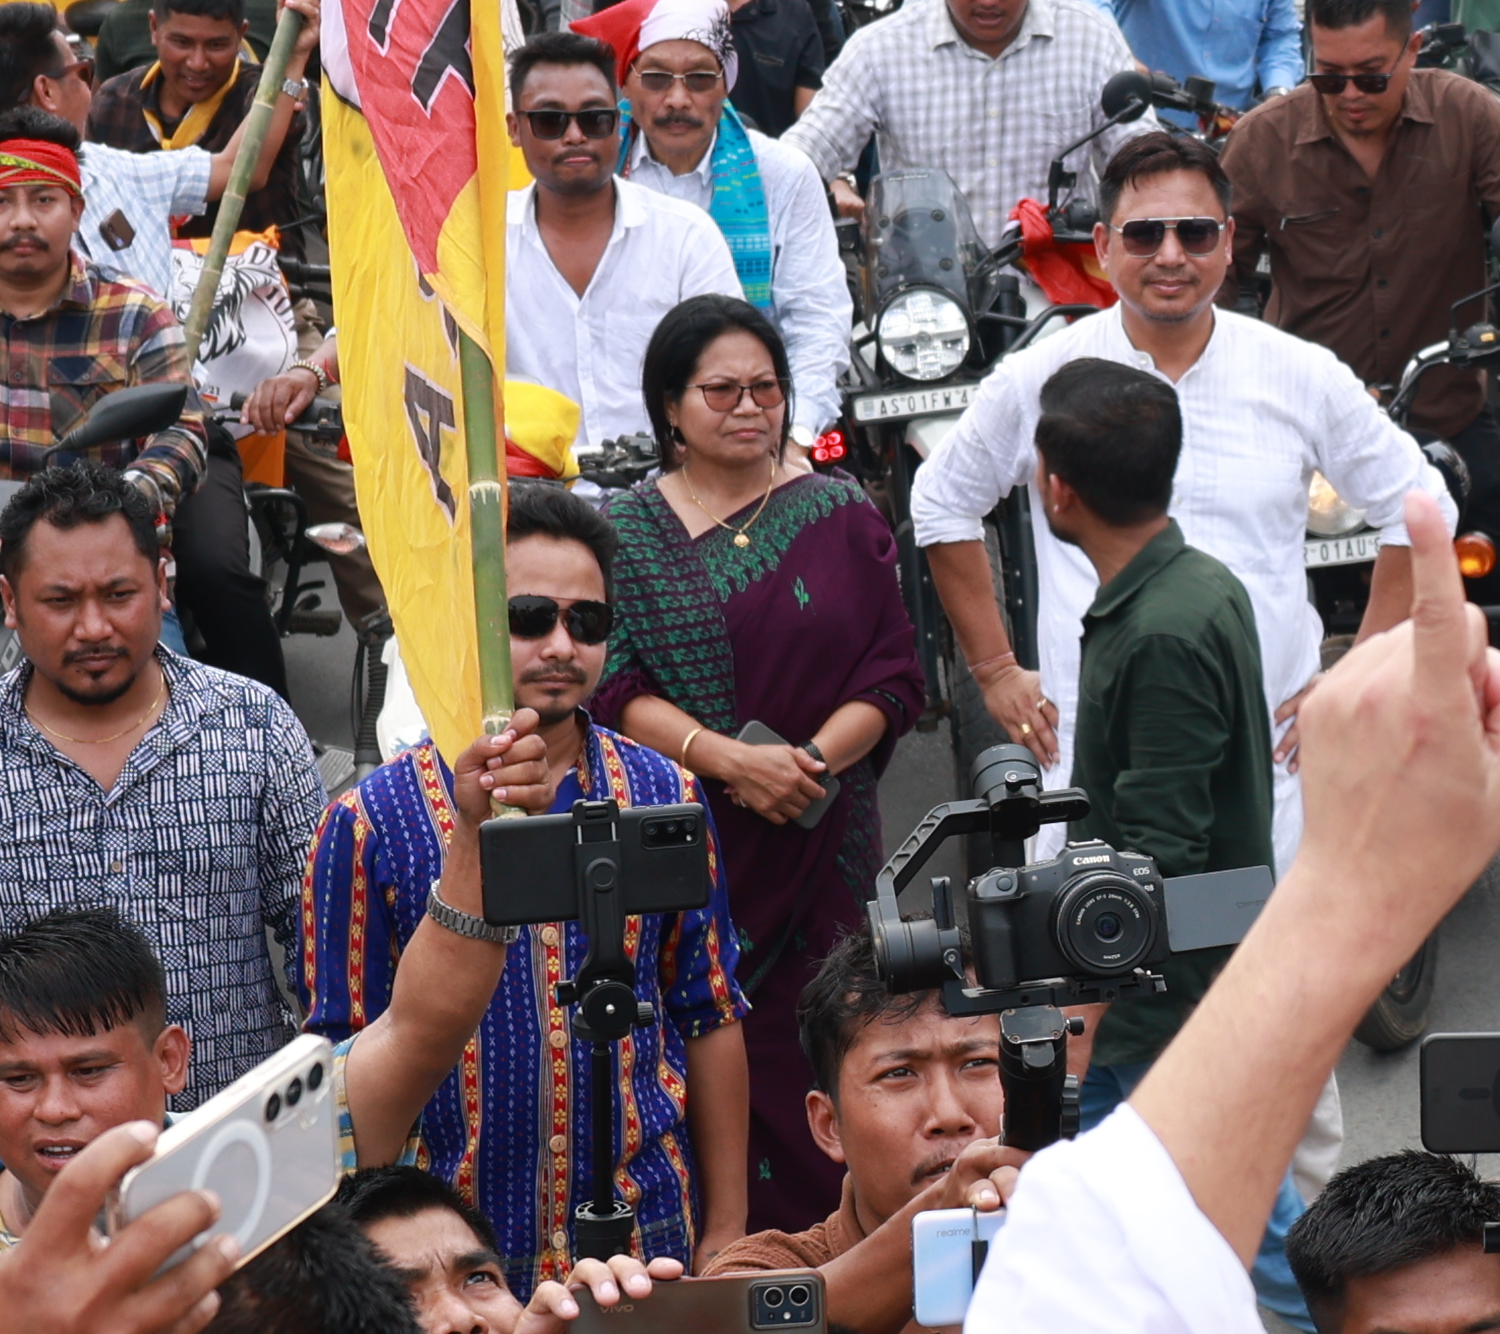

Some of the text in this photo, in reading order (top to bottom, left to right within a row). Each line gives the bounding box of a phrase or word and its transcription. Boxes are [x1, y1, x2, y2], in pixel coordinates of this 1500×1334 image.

[1073, 854, 1111, 866] Canon
[1133, 866, 1150, 876] EOS
[936, 1227, 972, 1239] realme
